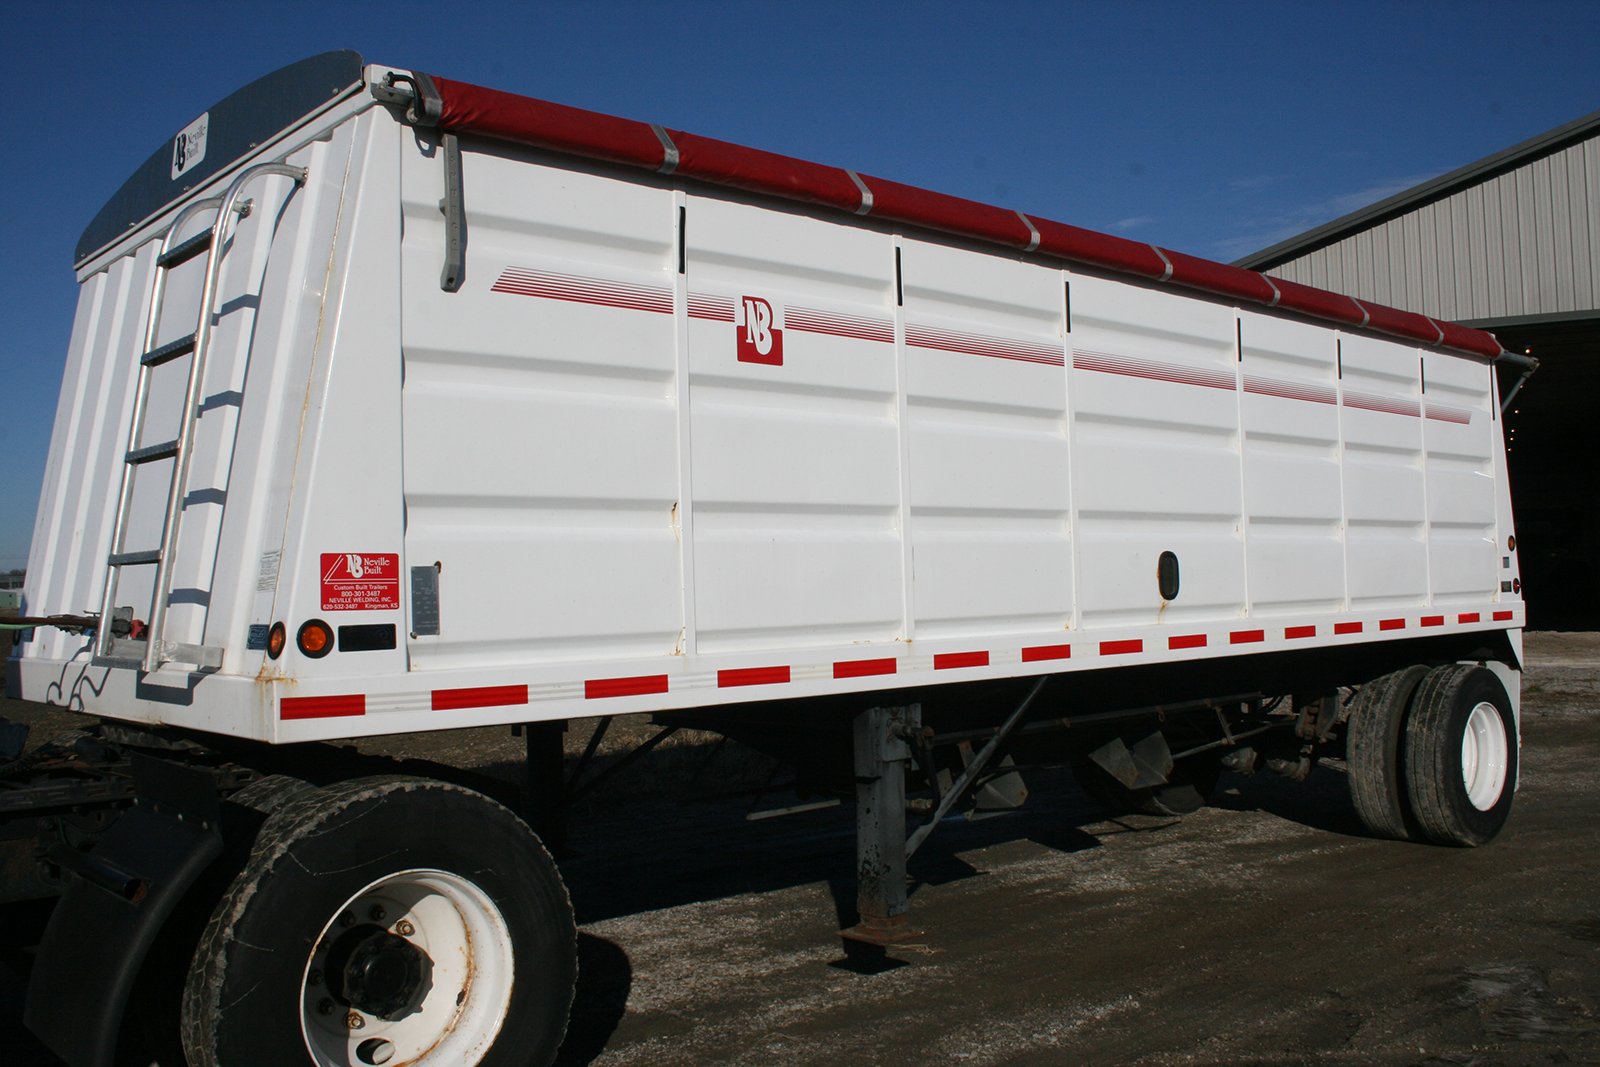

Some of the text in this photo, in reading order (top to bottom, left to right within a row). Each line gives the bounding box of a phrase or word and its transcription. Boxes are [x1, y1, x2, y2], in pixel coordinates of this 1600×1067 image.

[745, 299, 773, 355] NB
[364, 557, 390, 566] Neville
[364, 566, 383, 574] Built
